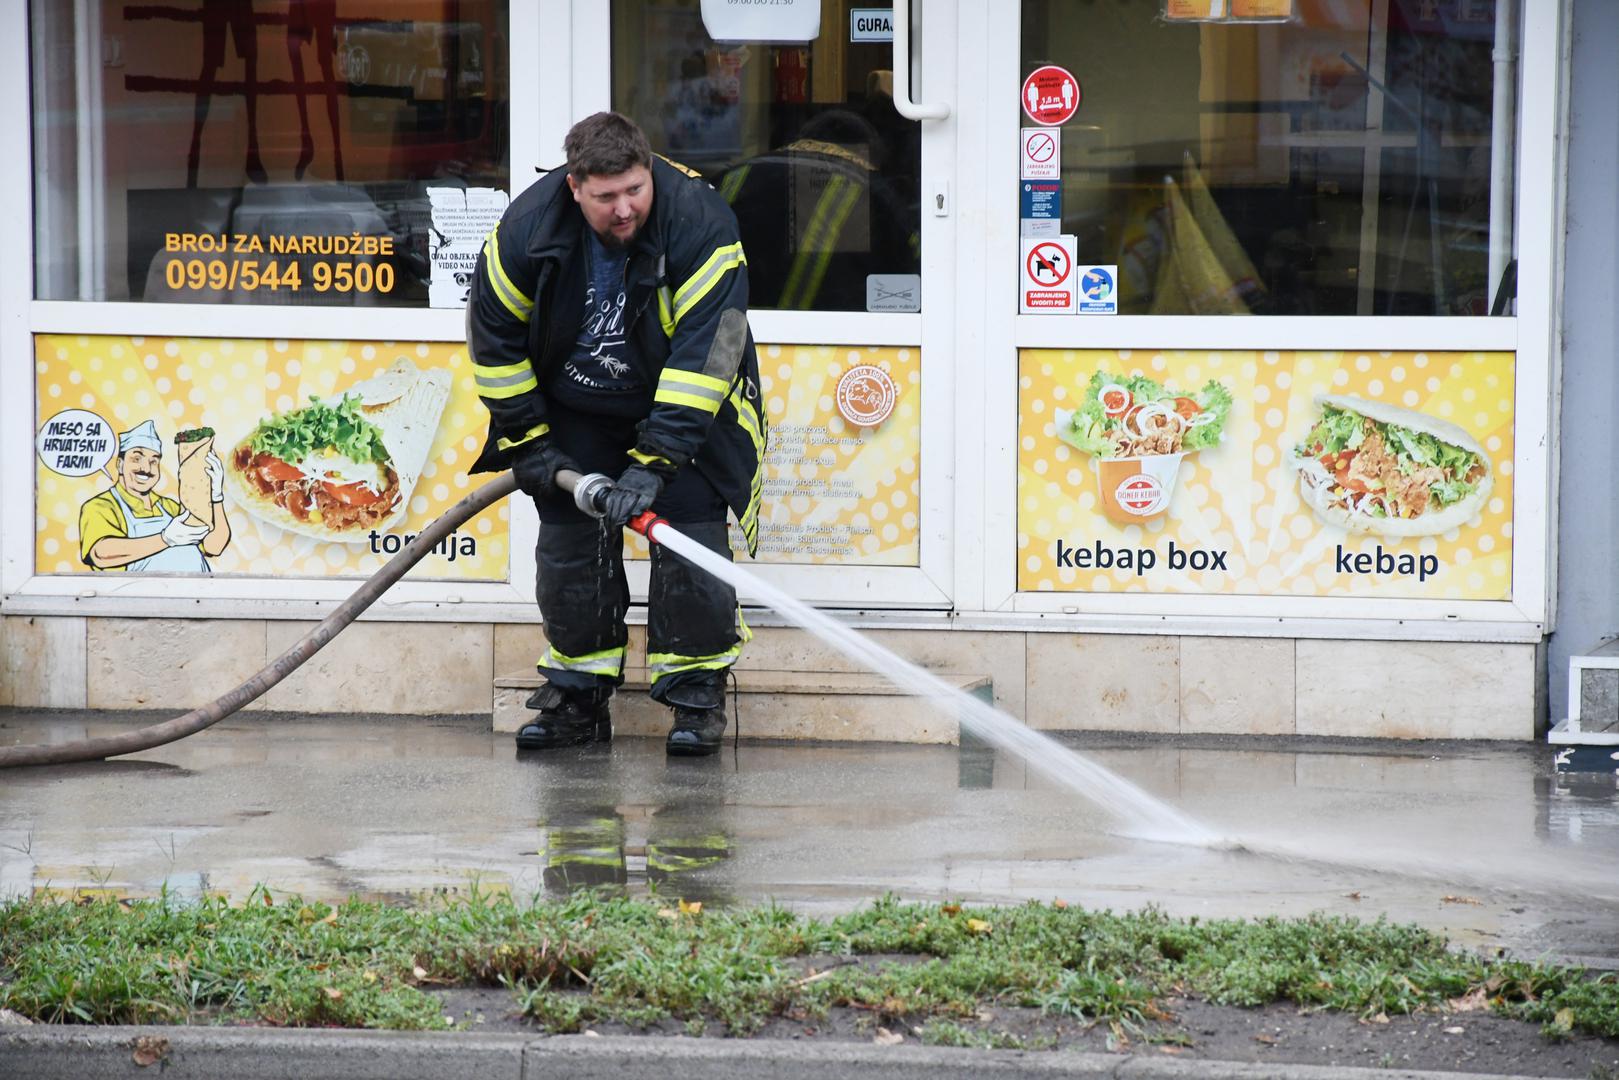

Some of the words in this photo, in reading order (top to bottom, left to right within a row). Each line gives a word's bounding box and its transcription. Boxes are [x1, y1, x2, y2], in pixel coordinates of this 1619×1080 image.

[165, 233, 227, 253] BROJ
[234, 234, 264, 254] ZA
[270, 231, 393, 255] NARUDŽBE
[166, 259, 302, 292] 099/544
[312, 261, 395, 293] 9500
[48, 422, 83, 436] MESO
[86, 423, 101, 436] SA
[43, 438, 107, 452] HRVATSKIH
[56, 455, 93, 469] FARMI
[368, 529, 476, 561] torlja
[1056, 539, 1156, 576] kebap
[1168, 541, 1228, 571] box
[1336, 544, 1440, 582] kebap
